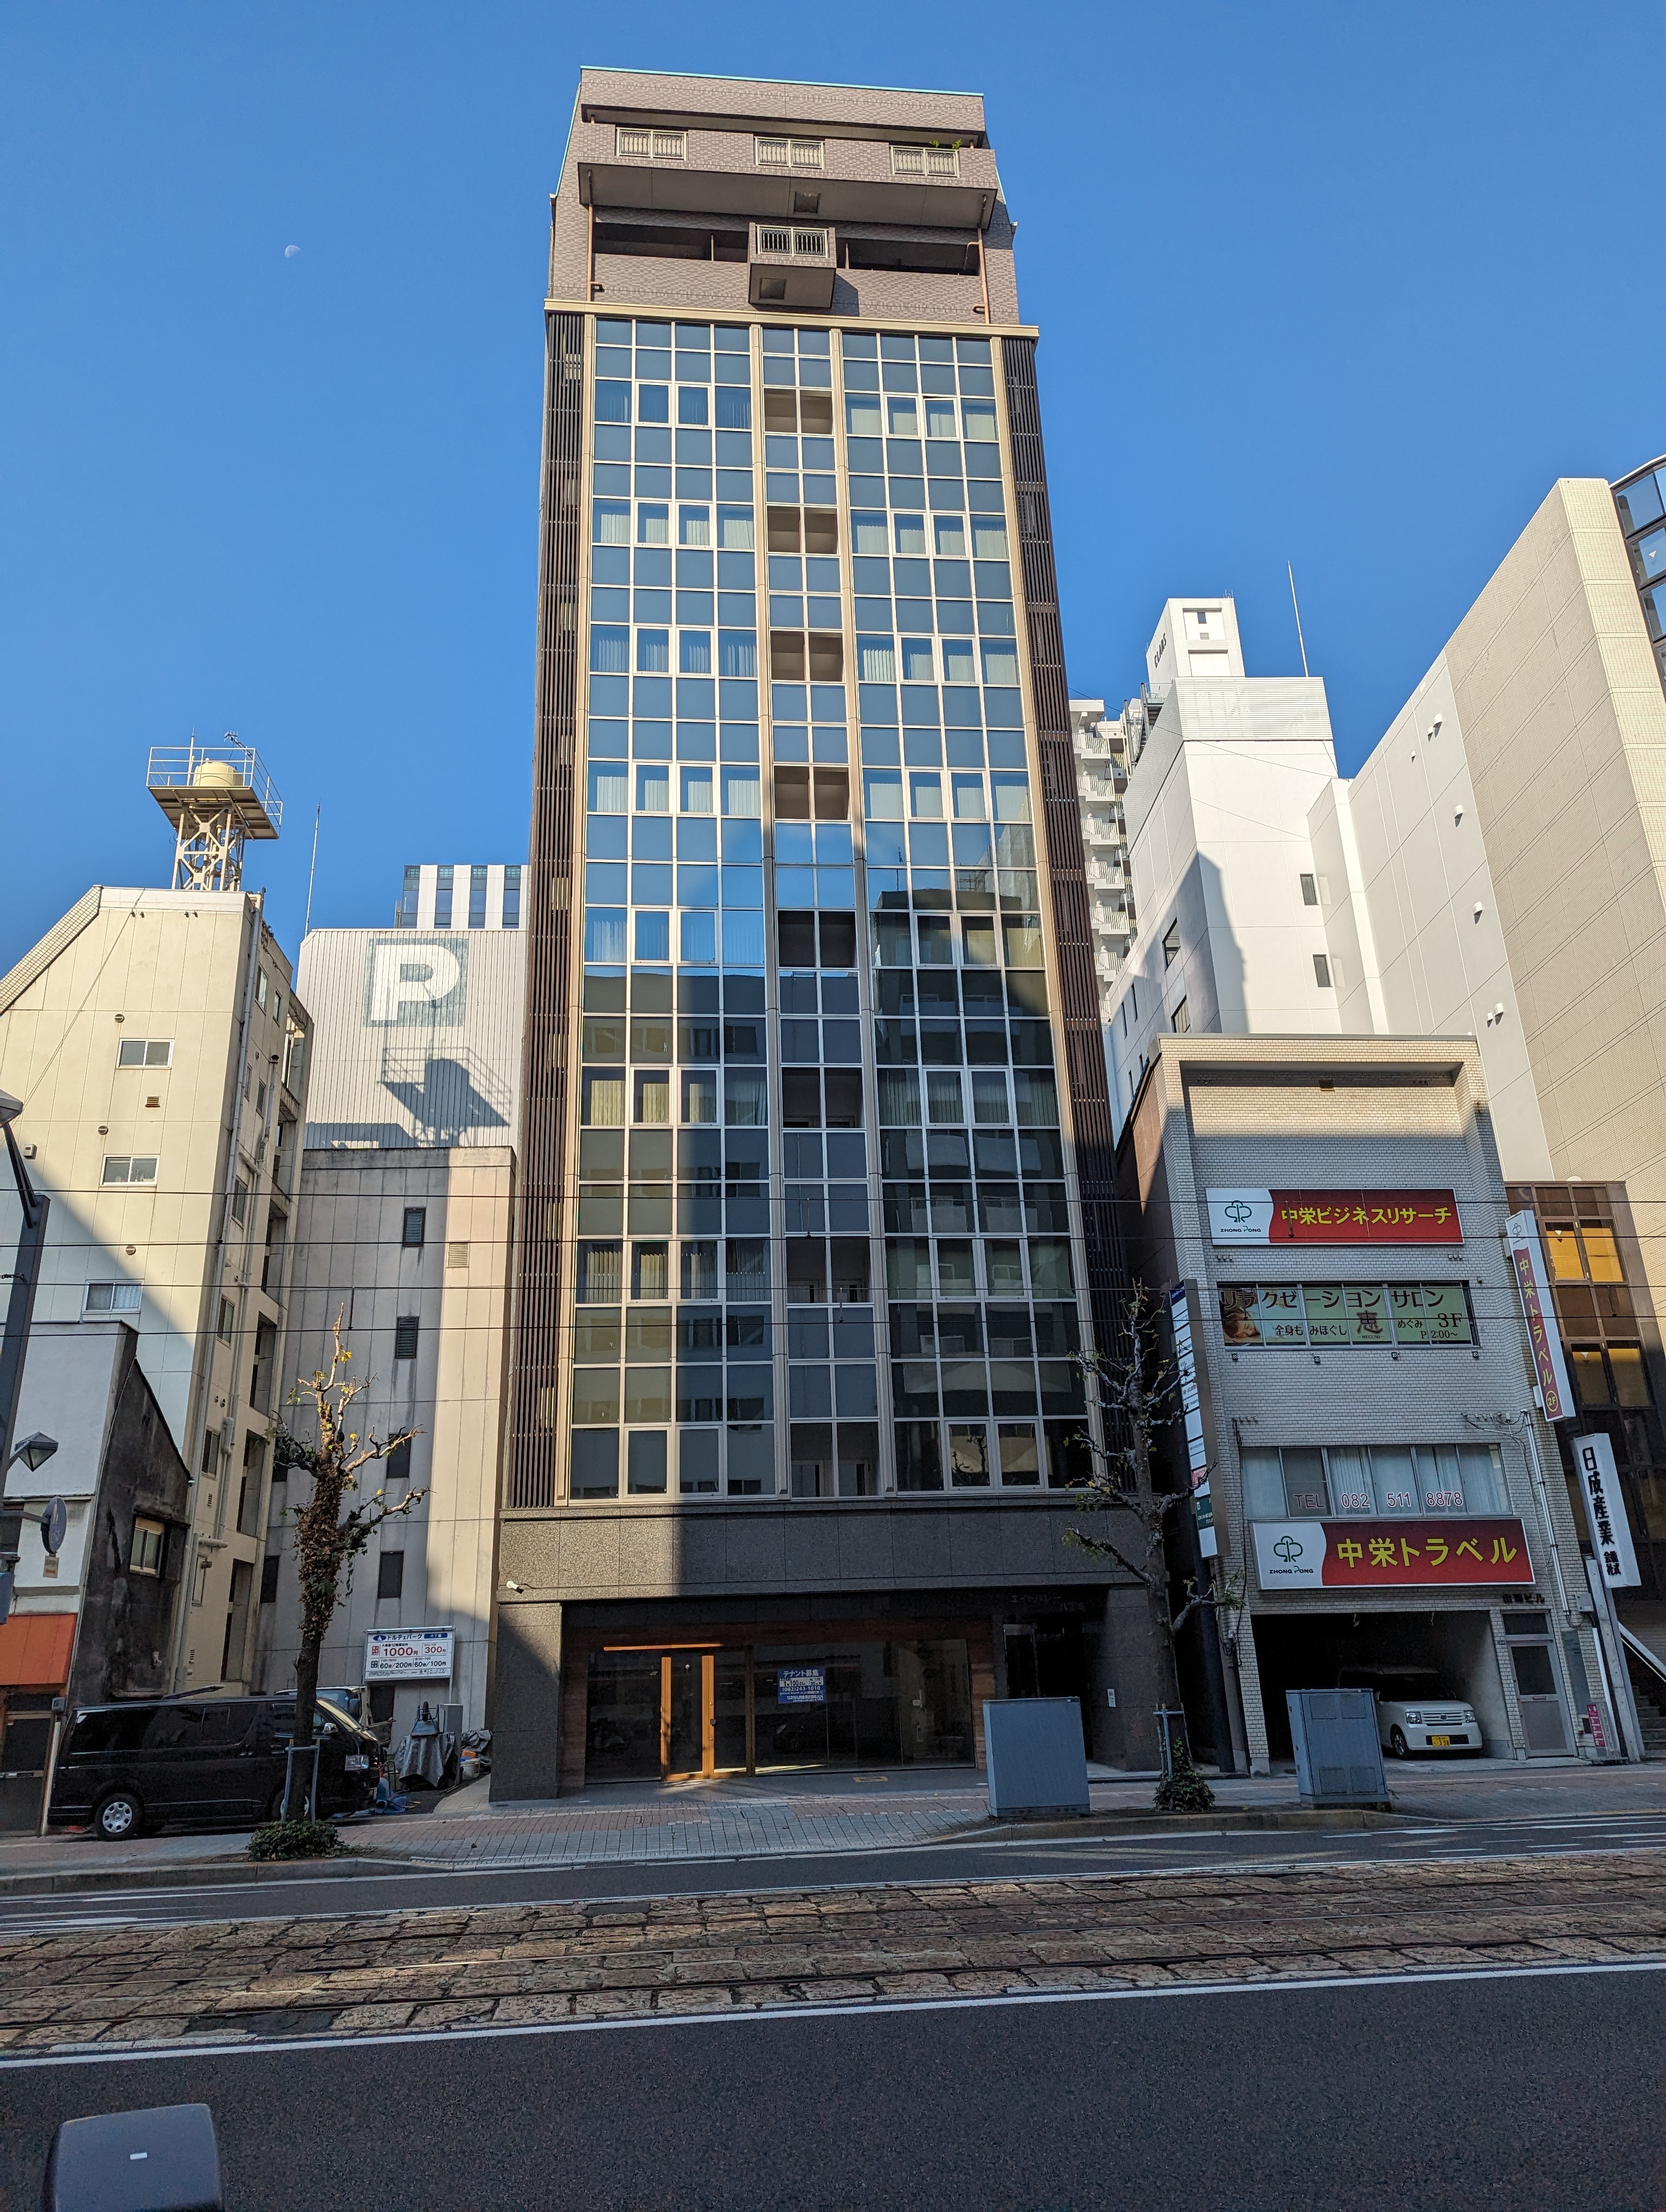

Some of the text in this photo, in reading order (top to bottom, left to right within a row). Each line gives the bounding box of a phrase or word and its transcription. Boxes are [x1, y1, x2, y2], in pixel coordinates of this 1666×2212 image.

[1154, 632, 1167, 668] CLARS
[371, 944, 459, 1020] P
[1281, 1206, 1452, 1225] 中栄ビジネスリサーチ
[1398, 1320, 1423, 1329] めぐみ
[1437, 1313, 1463, 1328] 3F
[1520, 1257, 1553, 1387] 中栄トラベル
[1275, 1324, 1347, 1336] 全身もみほぐし
[1293, 1491, 1463, 1509] TEL 082 511 8878
[1582, 1446, 1615, 1546] 日成産業
[1337, 1537, 1518, 1568] 中栄トラベル
[383, 1647, 418, 1657] 1000円
[783, 1669, 819, 1677] テナント募集
